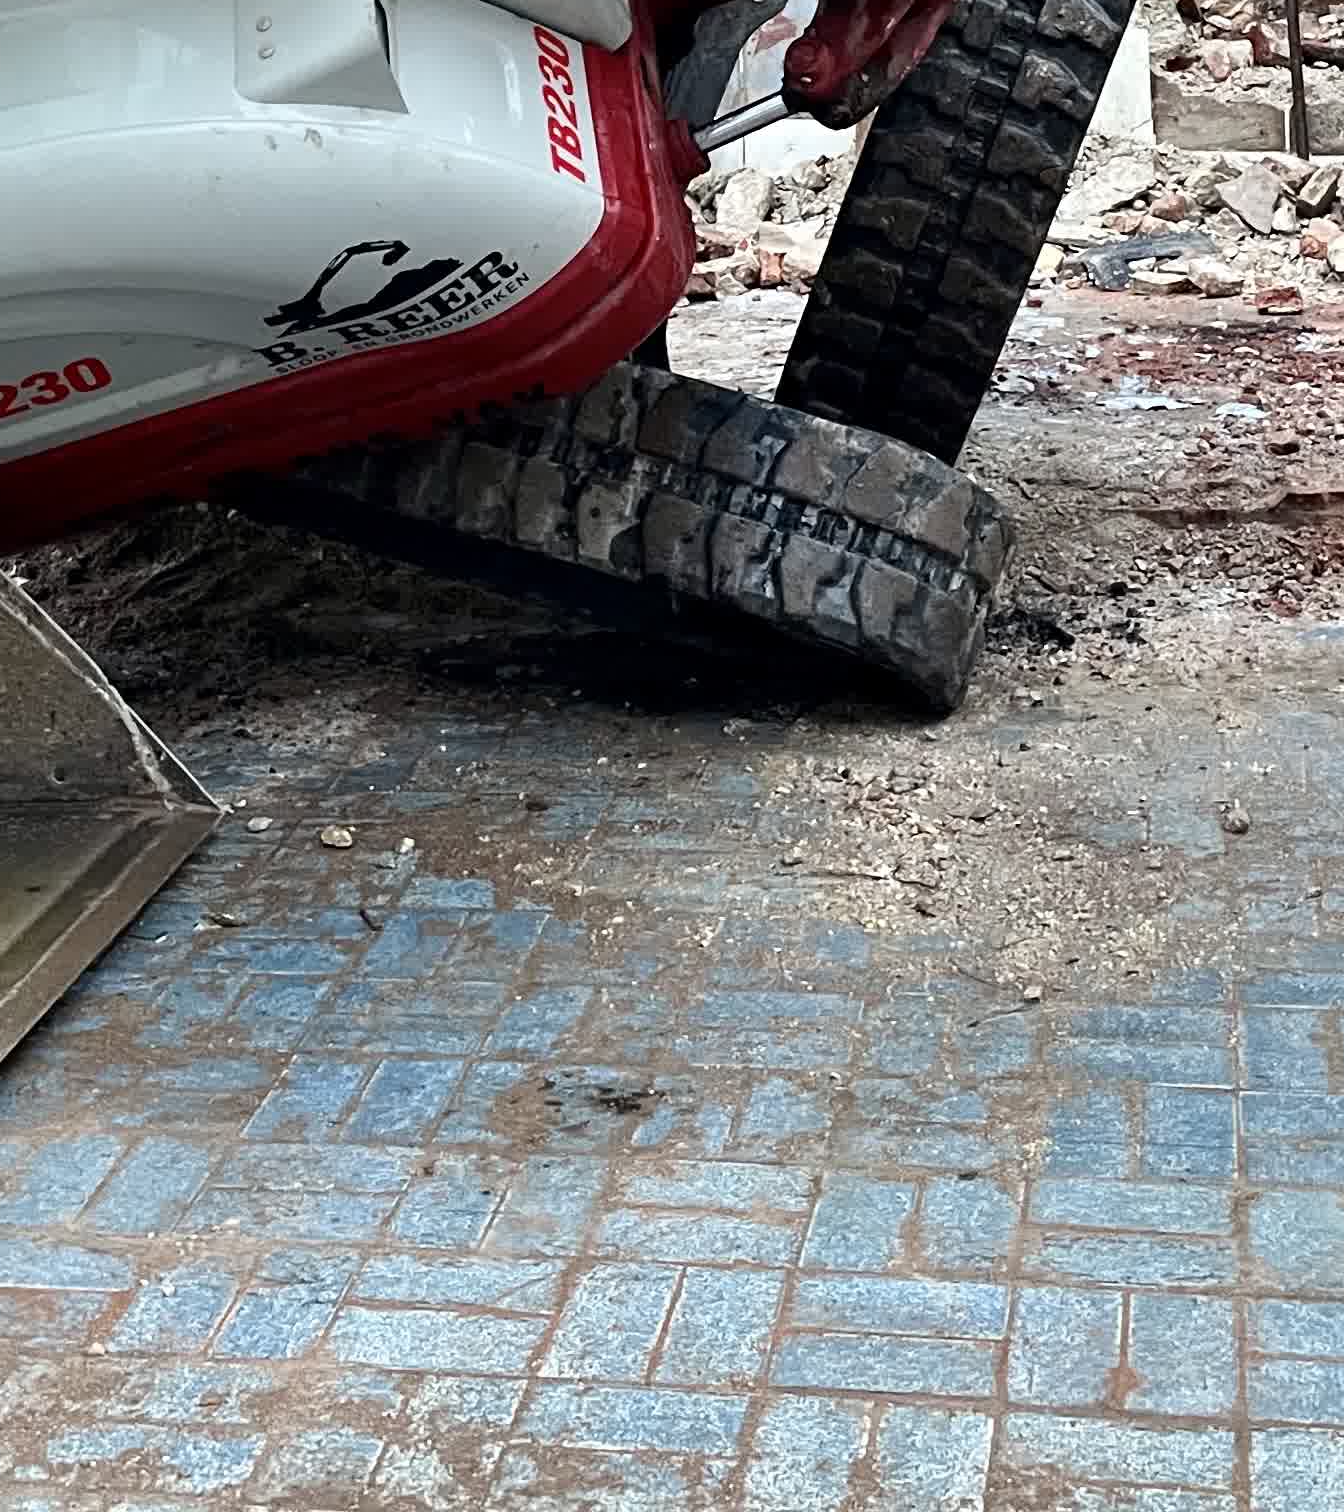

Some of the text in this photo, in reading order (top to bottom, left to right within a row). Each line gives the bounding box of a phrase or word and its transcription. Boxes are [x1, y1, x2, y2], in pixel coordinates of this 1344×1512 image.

[533, 25, 586, 184] TB230
[251, 250, 520, 368] B. REER
